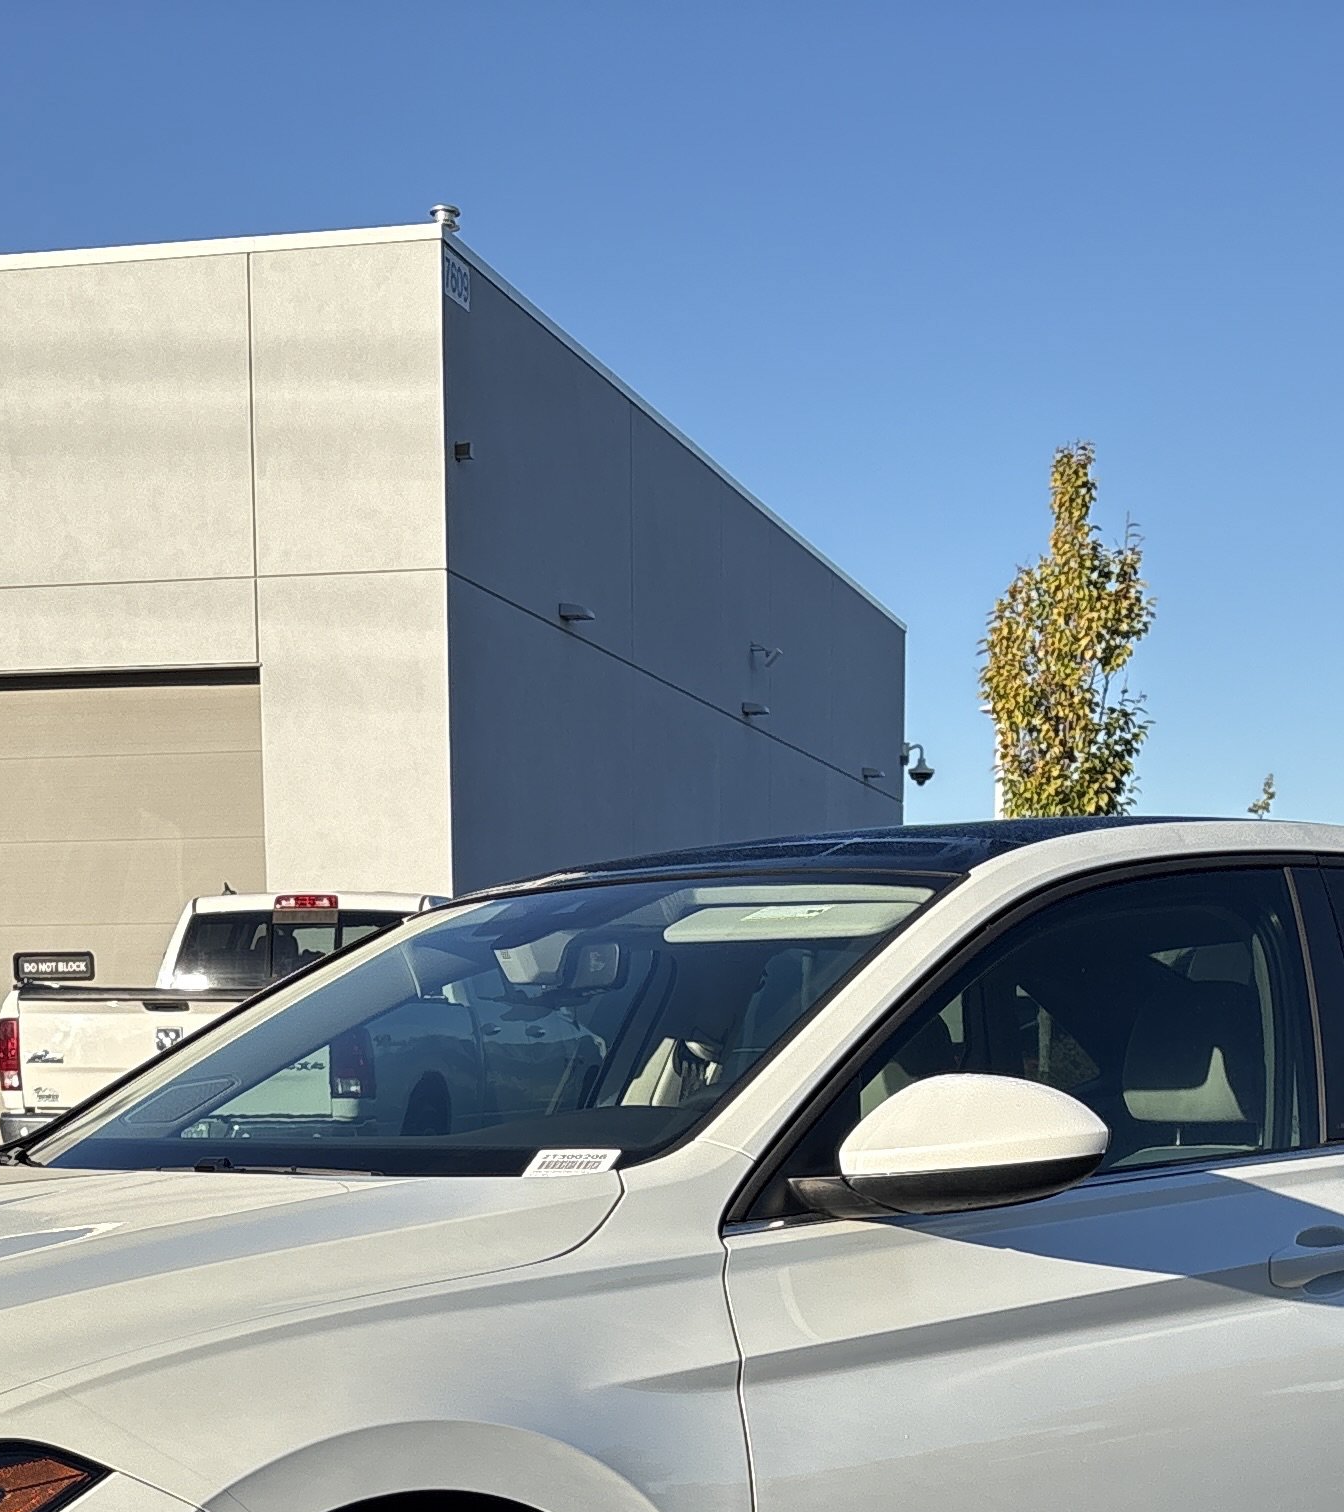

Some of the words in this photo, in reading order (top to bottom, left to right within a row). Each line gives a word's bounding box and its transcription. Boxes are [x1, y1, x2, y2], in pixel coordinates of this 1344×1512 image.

[23, 961, 37, 973] DO
[38, 961, 56, 973] NOT
[57, 961, 86, 973] BLOCK
